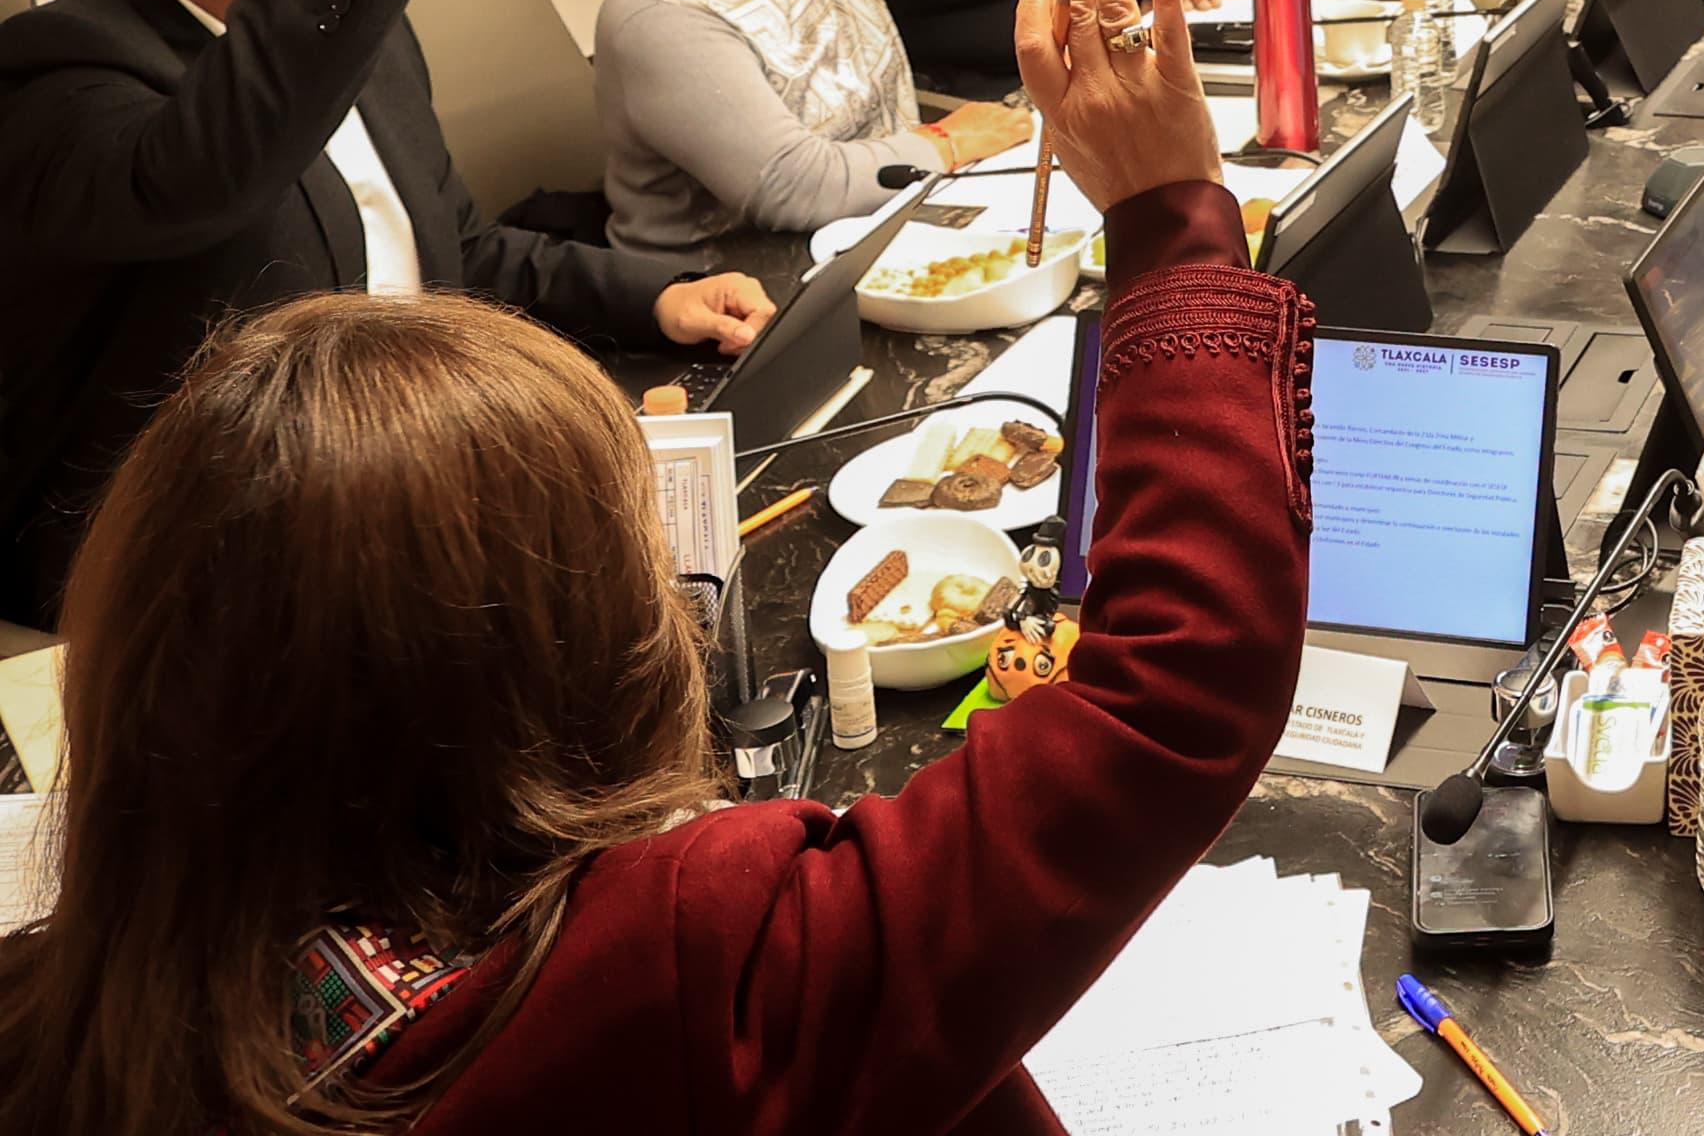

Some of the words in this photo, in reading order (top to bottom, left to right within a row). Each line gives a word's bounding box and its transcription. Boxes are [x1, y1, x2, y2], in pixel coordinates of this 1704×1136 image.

[1381, 349, 1447, 364] TLAXCALA
[1460, 355, 1520, 369] SESESP
[1305, 707, 1363, 726] CISNEROS
